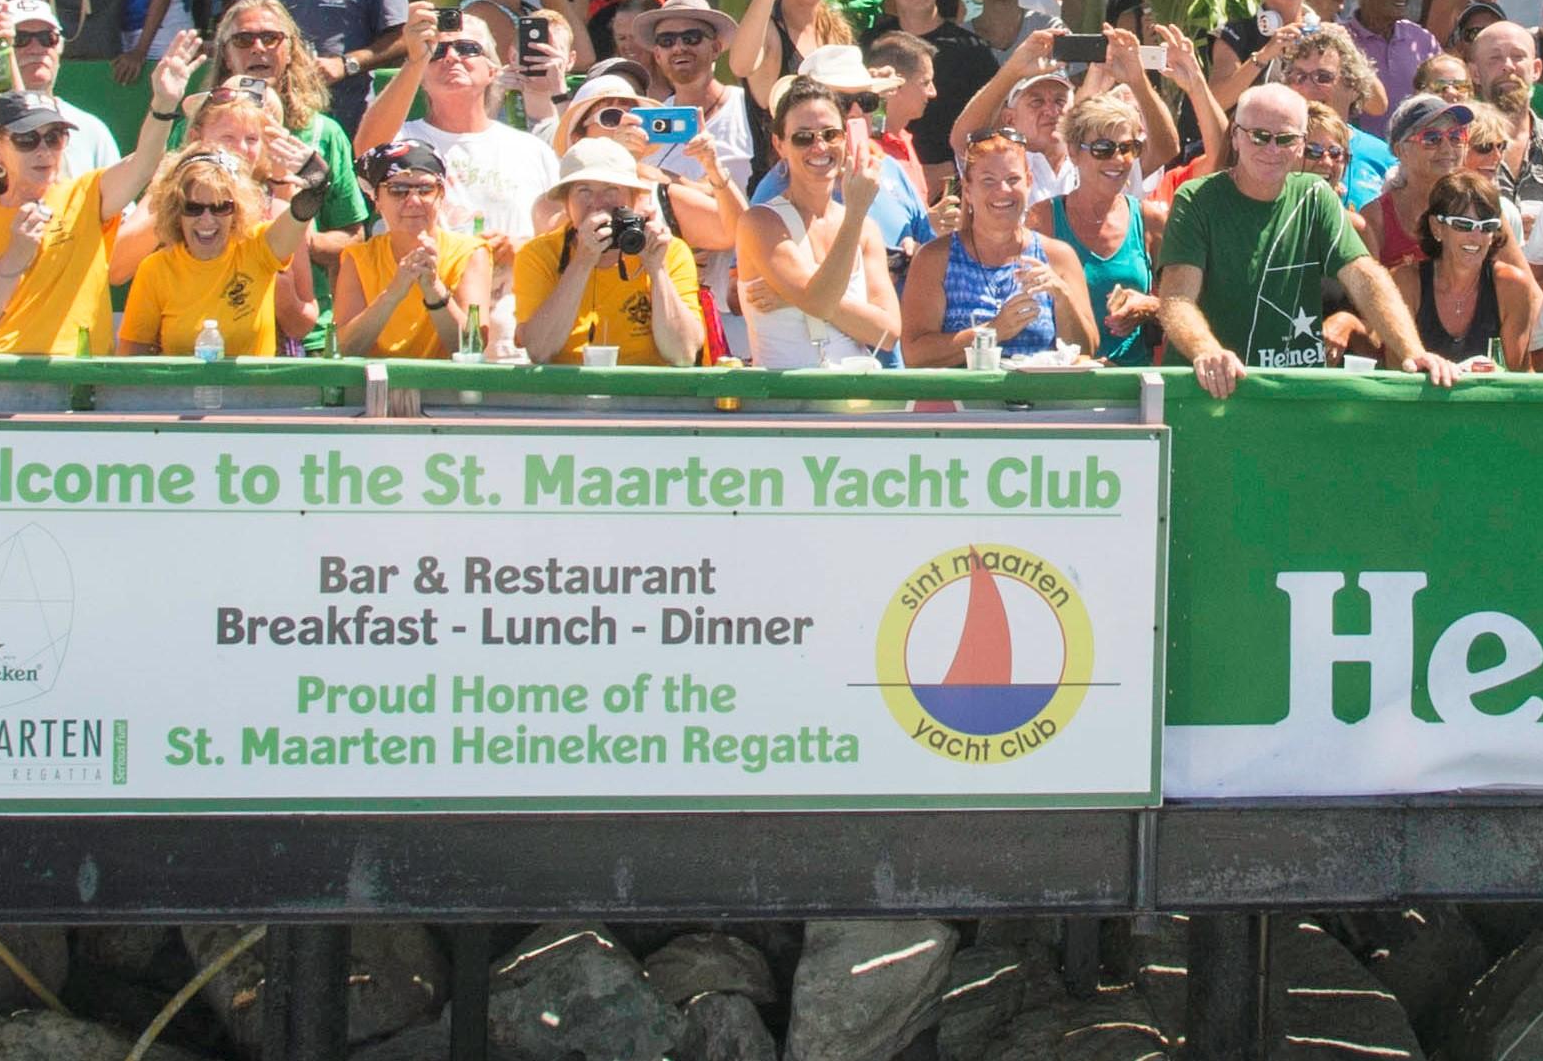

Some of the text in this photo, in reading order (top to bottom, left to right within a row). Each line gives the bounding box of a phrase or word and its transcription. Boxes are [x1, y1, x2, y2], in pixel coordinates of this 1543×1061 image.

[215, 453, 280, 505] to
[300, 451, 403, 505] the
[421, 452, 502, 507] St.
[523, 453, 784, 507] Maarten
[801, 454, 969, 509] Yacht
[985, 455, 1122, 510] Club
[319, 555, 717, 596] Bar & Restaurant
[900, 551, 1070, 611] sint maarten
[216, 605, 439, 646] Breakfast
[481, 605, 618, 647] Lunch
[661, 606, 815, 646] Dinner
[297, 673, 737, 715] Proud Home of the
[164, 726, 861, 774] St. Maarten Heineken Regatta
[911, 717, 1057, 762] yacht club
[12, 768, 103, 783] REGATTA
